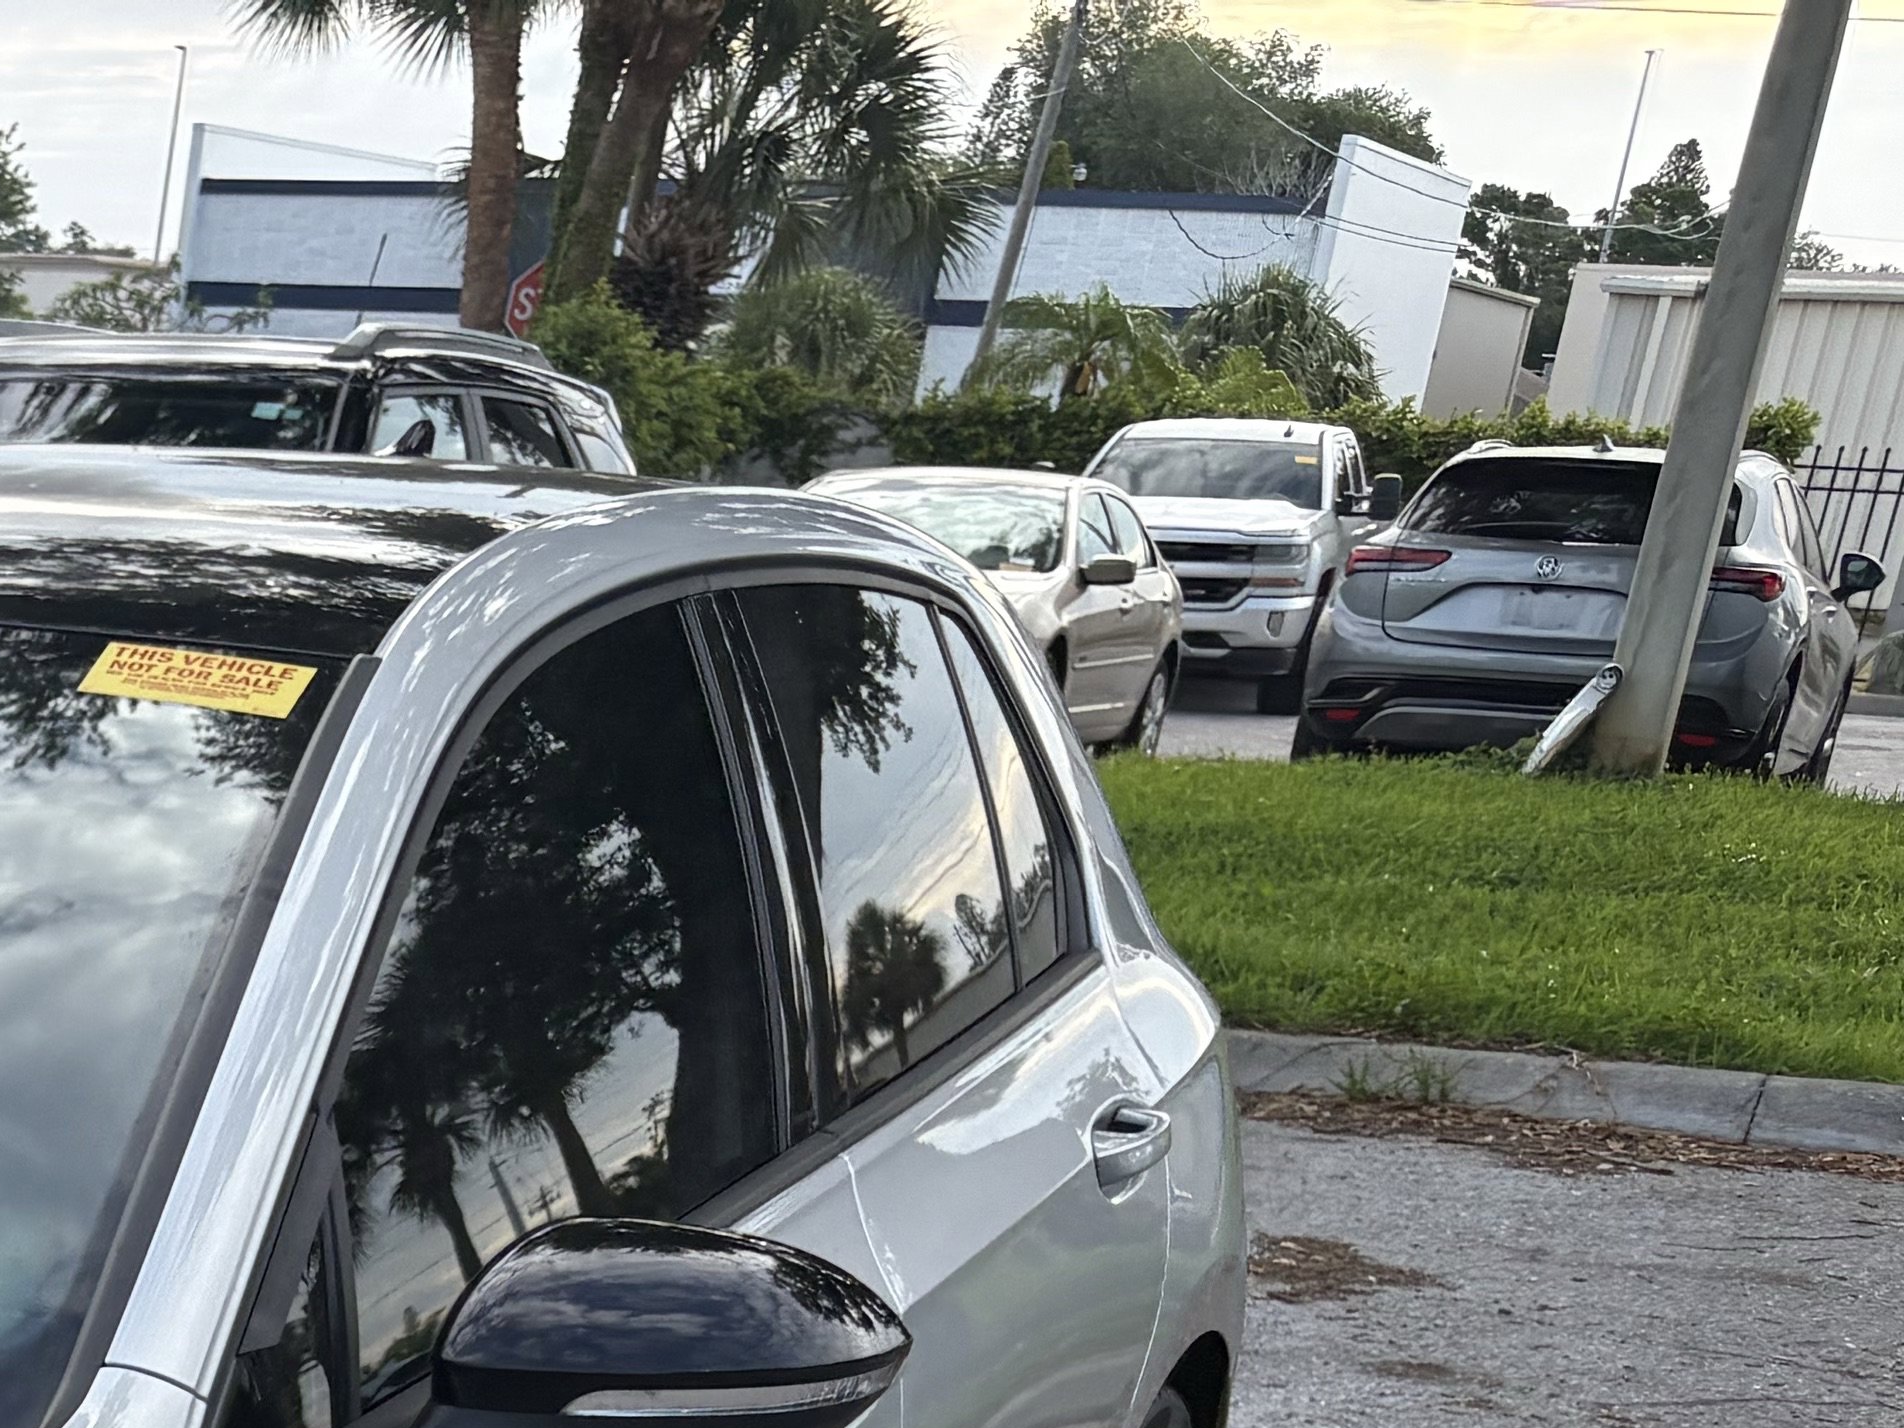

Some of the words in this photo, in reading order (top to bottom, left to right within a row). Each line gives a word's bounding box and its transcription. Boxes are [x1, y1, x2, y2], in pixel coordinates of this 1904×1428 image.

[109, 660, 159, 674] NOT
[163, 667, 213, 681] FOR
[219, 674, 284, 691] SALE
[114, 646, 174, 663] THIS
[183, 653, 299, 680] VEHICLE
